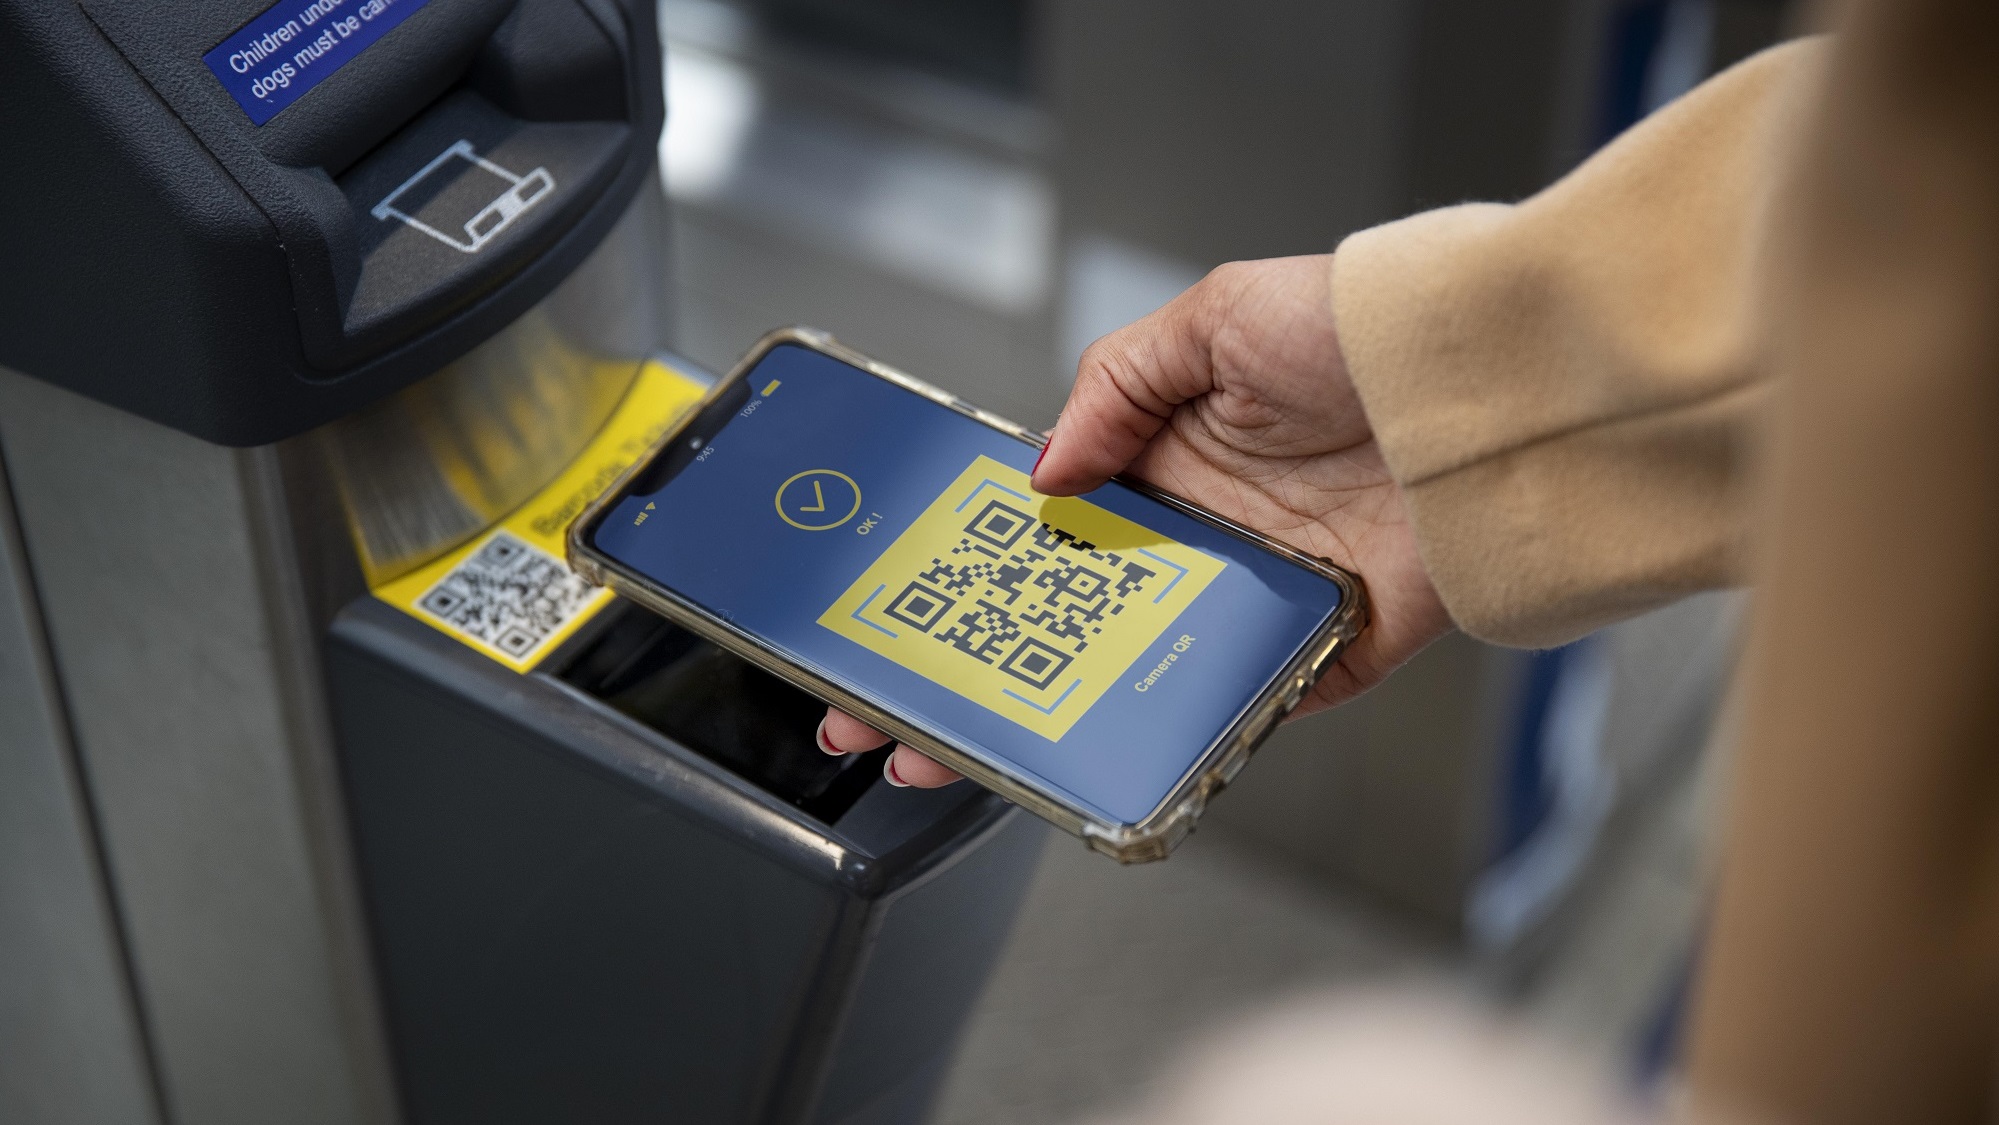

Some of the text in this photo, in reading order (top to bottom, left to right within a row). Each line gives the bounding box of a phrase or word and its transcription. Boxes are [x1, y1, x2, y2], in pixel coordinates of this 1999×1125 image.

[229, 18, 302, 74] Children
[251, 61, 297, 99] dogs
[293, 29, 339, 68] must
[331, 15, 360, 38] be
[740, 399, 762, 418] 100%
[696, 445, 715, 462] 9:45
[856, 517, 879, 536] OK
[1134, 634, 1197, 692] Camera QR
